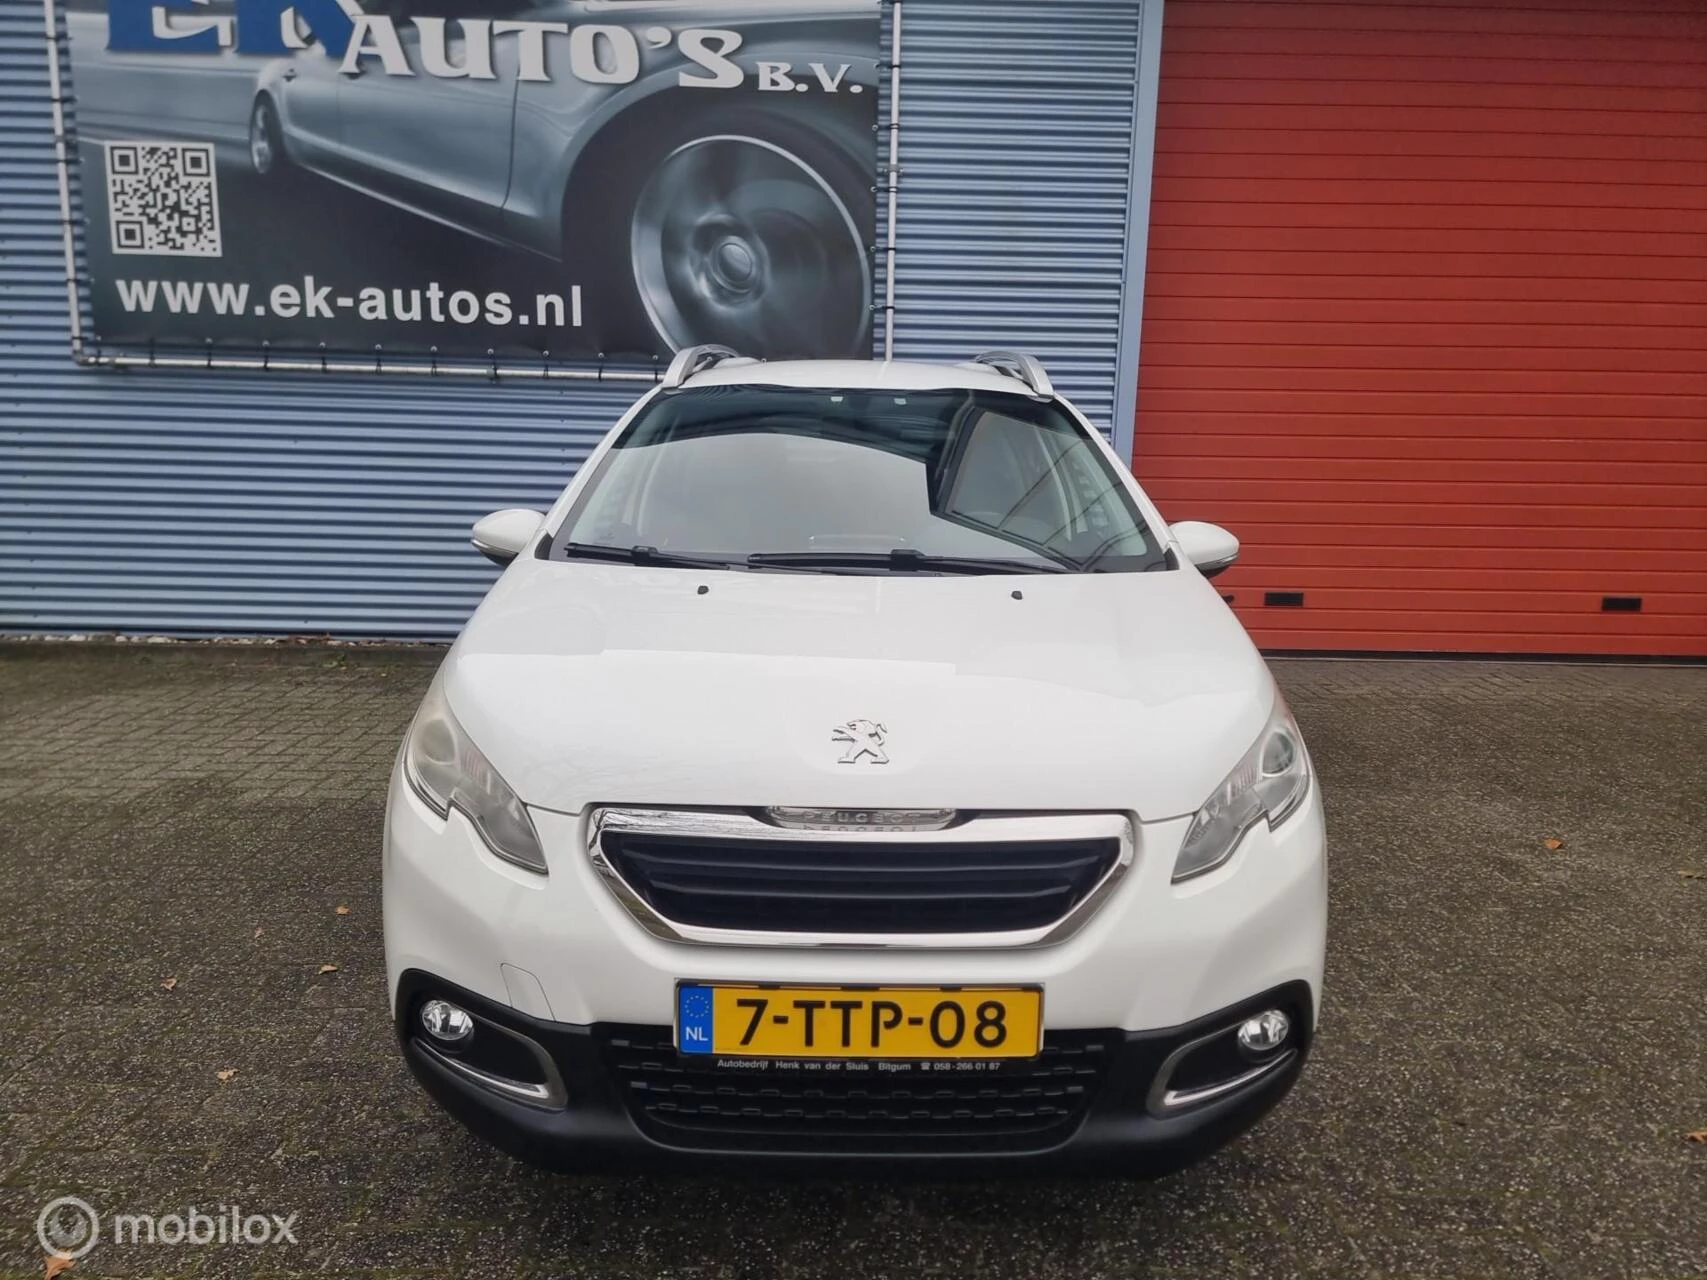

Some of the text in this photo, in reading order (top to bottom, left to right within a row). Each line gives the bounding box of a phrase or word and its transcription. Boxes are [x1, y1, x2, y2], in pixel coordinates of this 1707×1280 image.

[337, 15, 745, 88] AUTO'S
[755, 61, 863, 93] B.V.
[115, 275, 582, 327] www.ek-autos.nl
[802, 811, 921, 823] PEUGEOT
[685, 1026, 709, 1042] NL
[736, 998, 1007, 1049] 7-TTP-08
[717, 1059, 769, 1070] Autobedrijf
[775, 1060, 800, 1070] Henk
[804, 1062, 821, 1071] van
[825, 1061, 841, 1071] der
[846, 1061, 869, 1071] Sluis
[975, 1062, 986, 1071] 01
